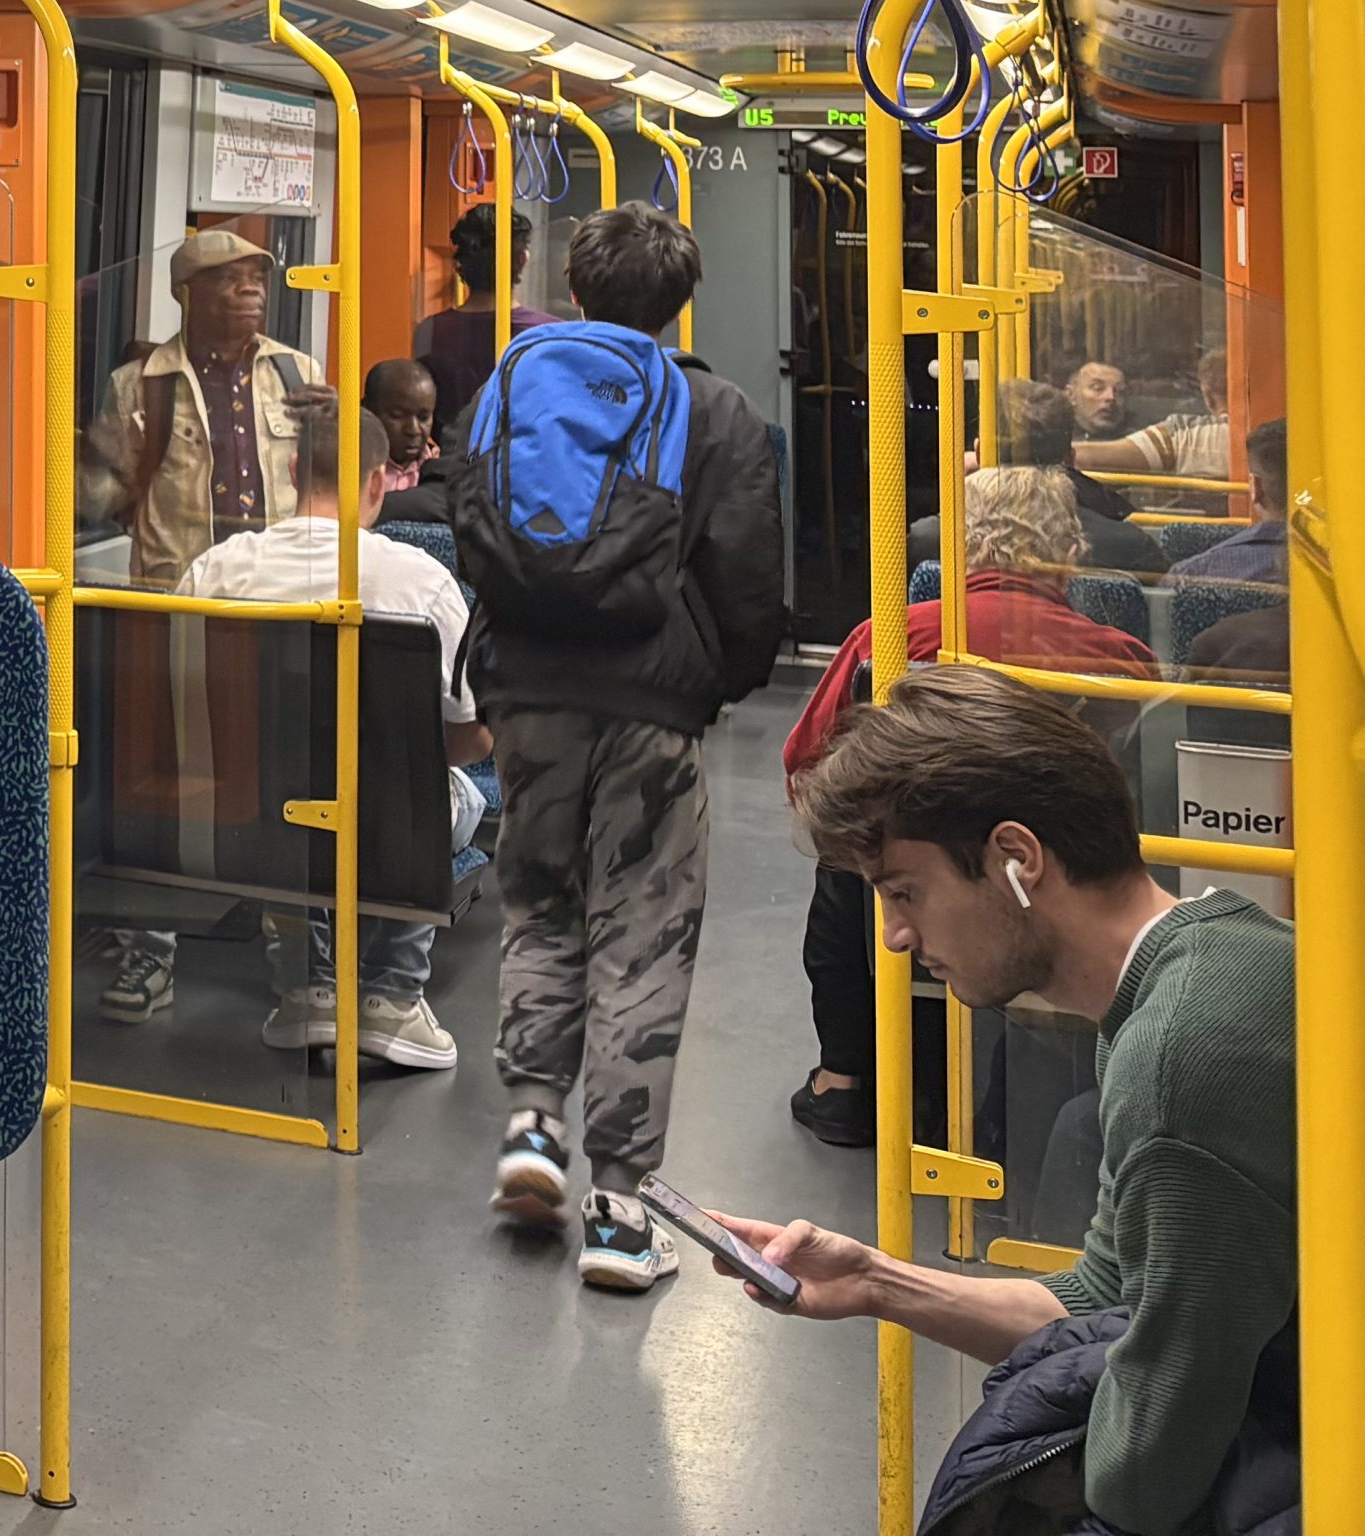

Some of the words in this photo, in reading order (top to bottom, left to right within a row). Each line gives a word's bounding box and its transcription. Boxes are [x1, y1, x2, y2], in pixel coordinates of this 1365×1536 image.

[744, 108, 774, 126] U5
[729, 146, 748, 171] A
[1183, 799, 1286, 836] Papier
